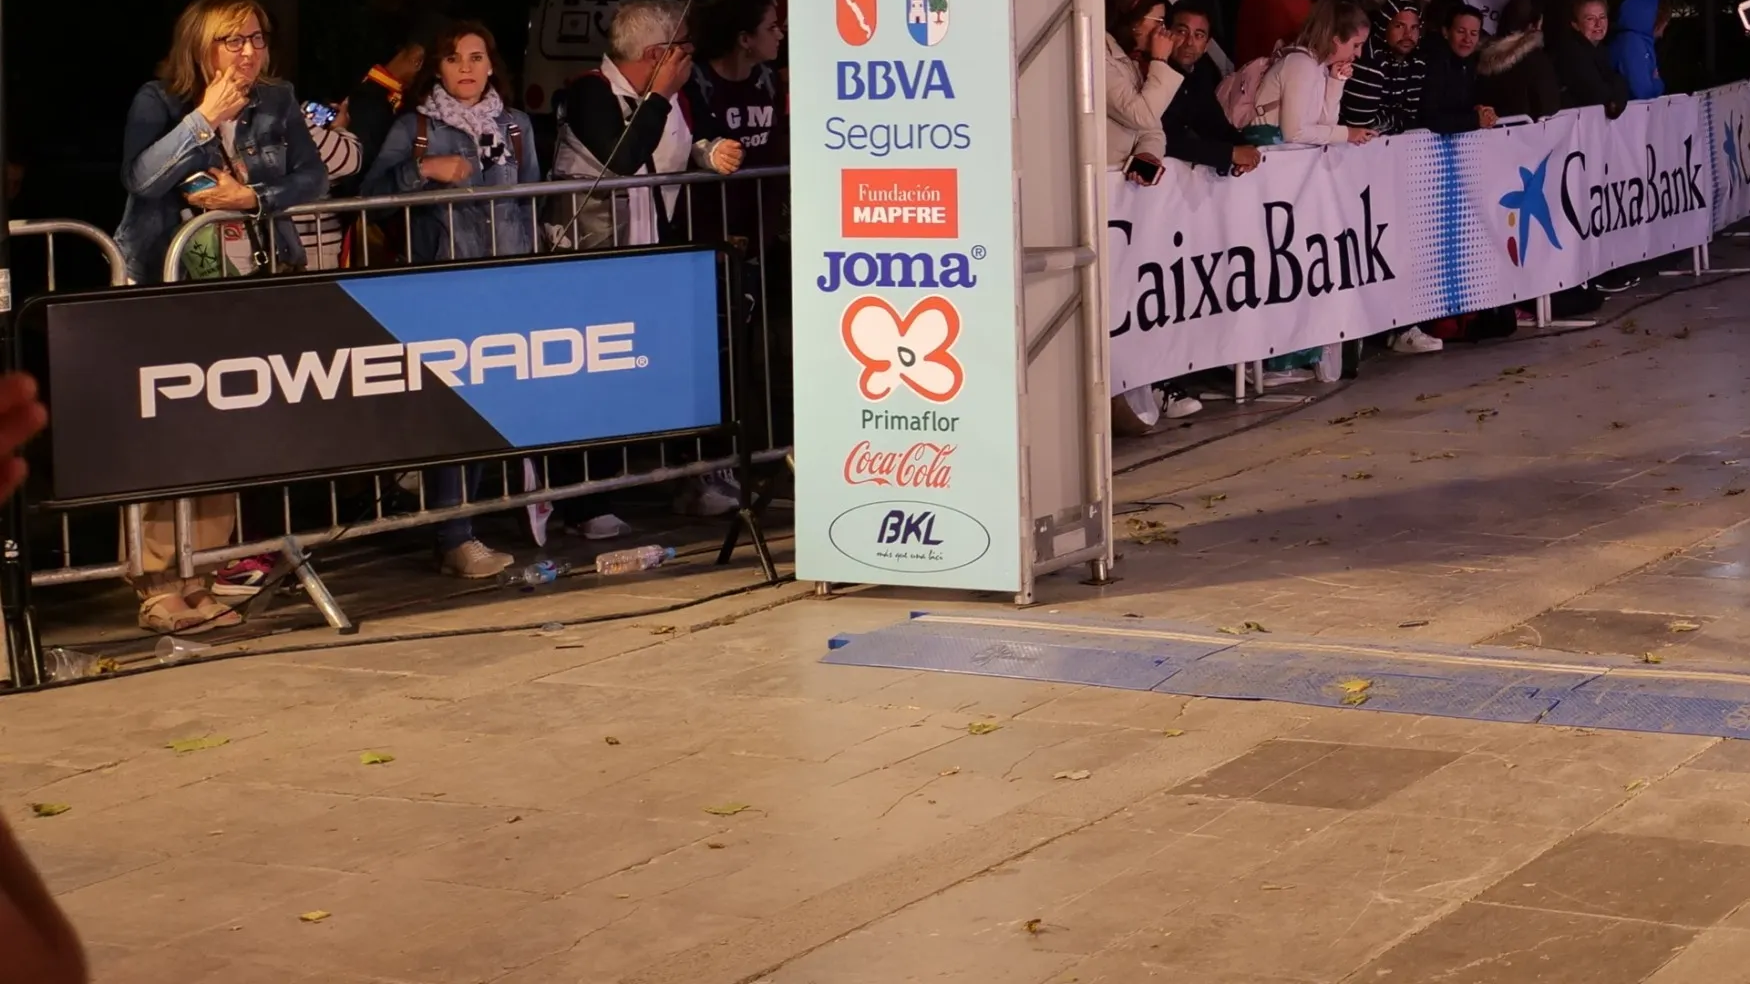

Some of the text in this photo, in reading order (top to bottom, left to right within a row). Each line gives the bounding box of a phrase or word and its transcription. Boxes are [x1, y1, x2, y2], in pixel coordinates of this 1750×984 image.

[836, 59, 956, 101] BBVA
[824, 117, 971, 157] Seguros
[858, 183, 941, 204] Fundación
[1560, 135, 1707, 242] CaixaBank
[852, 207, 946, 224] MAPFRE
[138, 321, 636, 418] POWERADE
[861, 409, 960, 432] Primaflor
[877, 509, 944, 545] BKL
